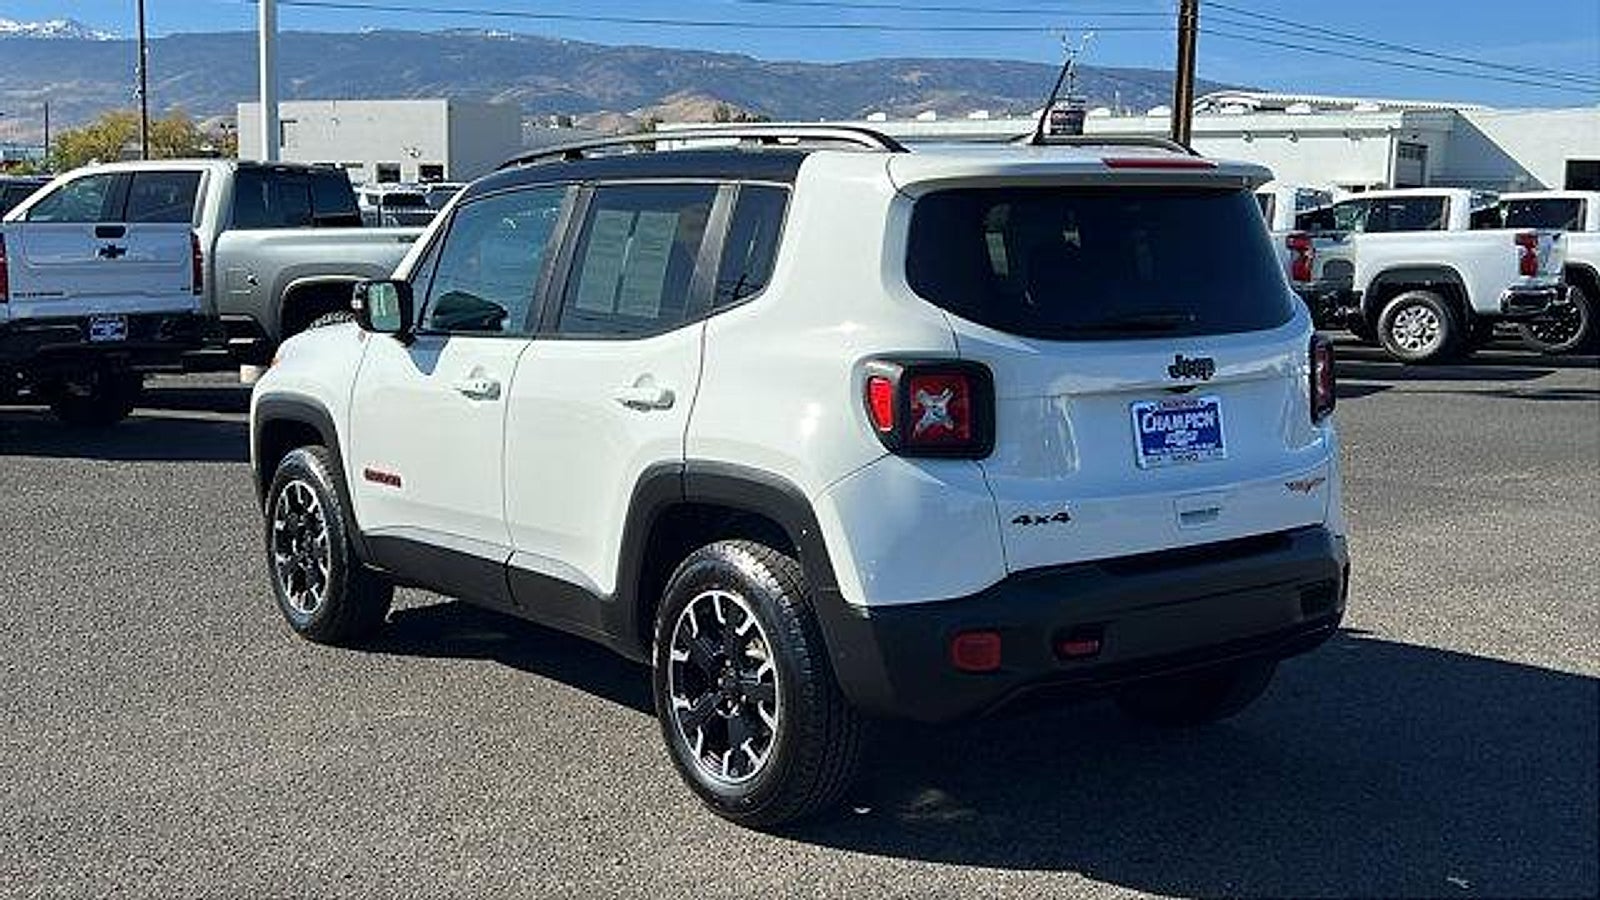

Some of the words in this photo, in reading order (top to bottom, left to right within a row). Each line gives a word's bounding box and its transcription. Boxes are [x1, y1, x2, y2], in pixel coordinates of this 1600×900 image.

[1168, 354, 1216, 381] Jeep
[1142, 411, 1215, 434] CHAMPION
[1011, 512, 1071, 526] 4x4
